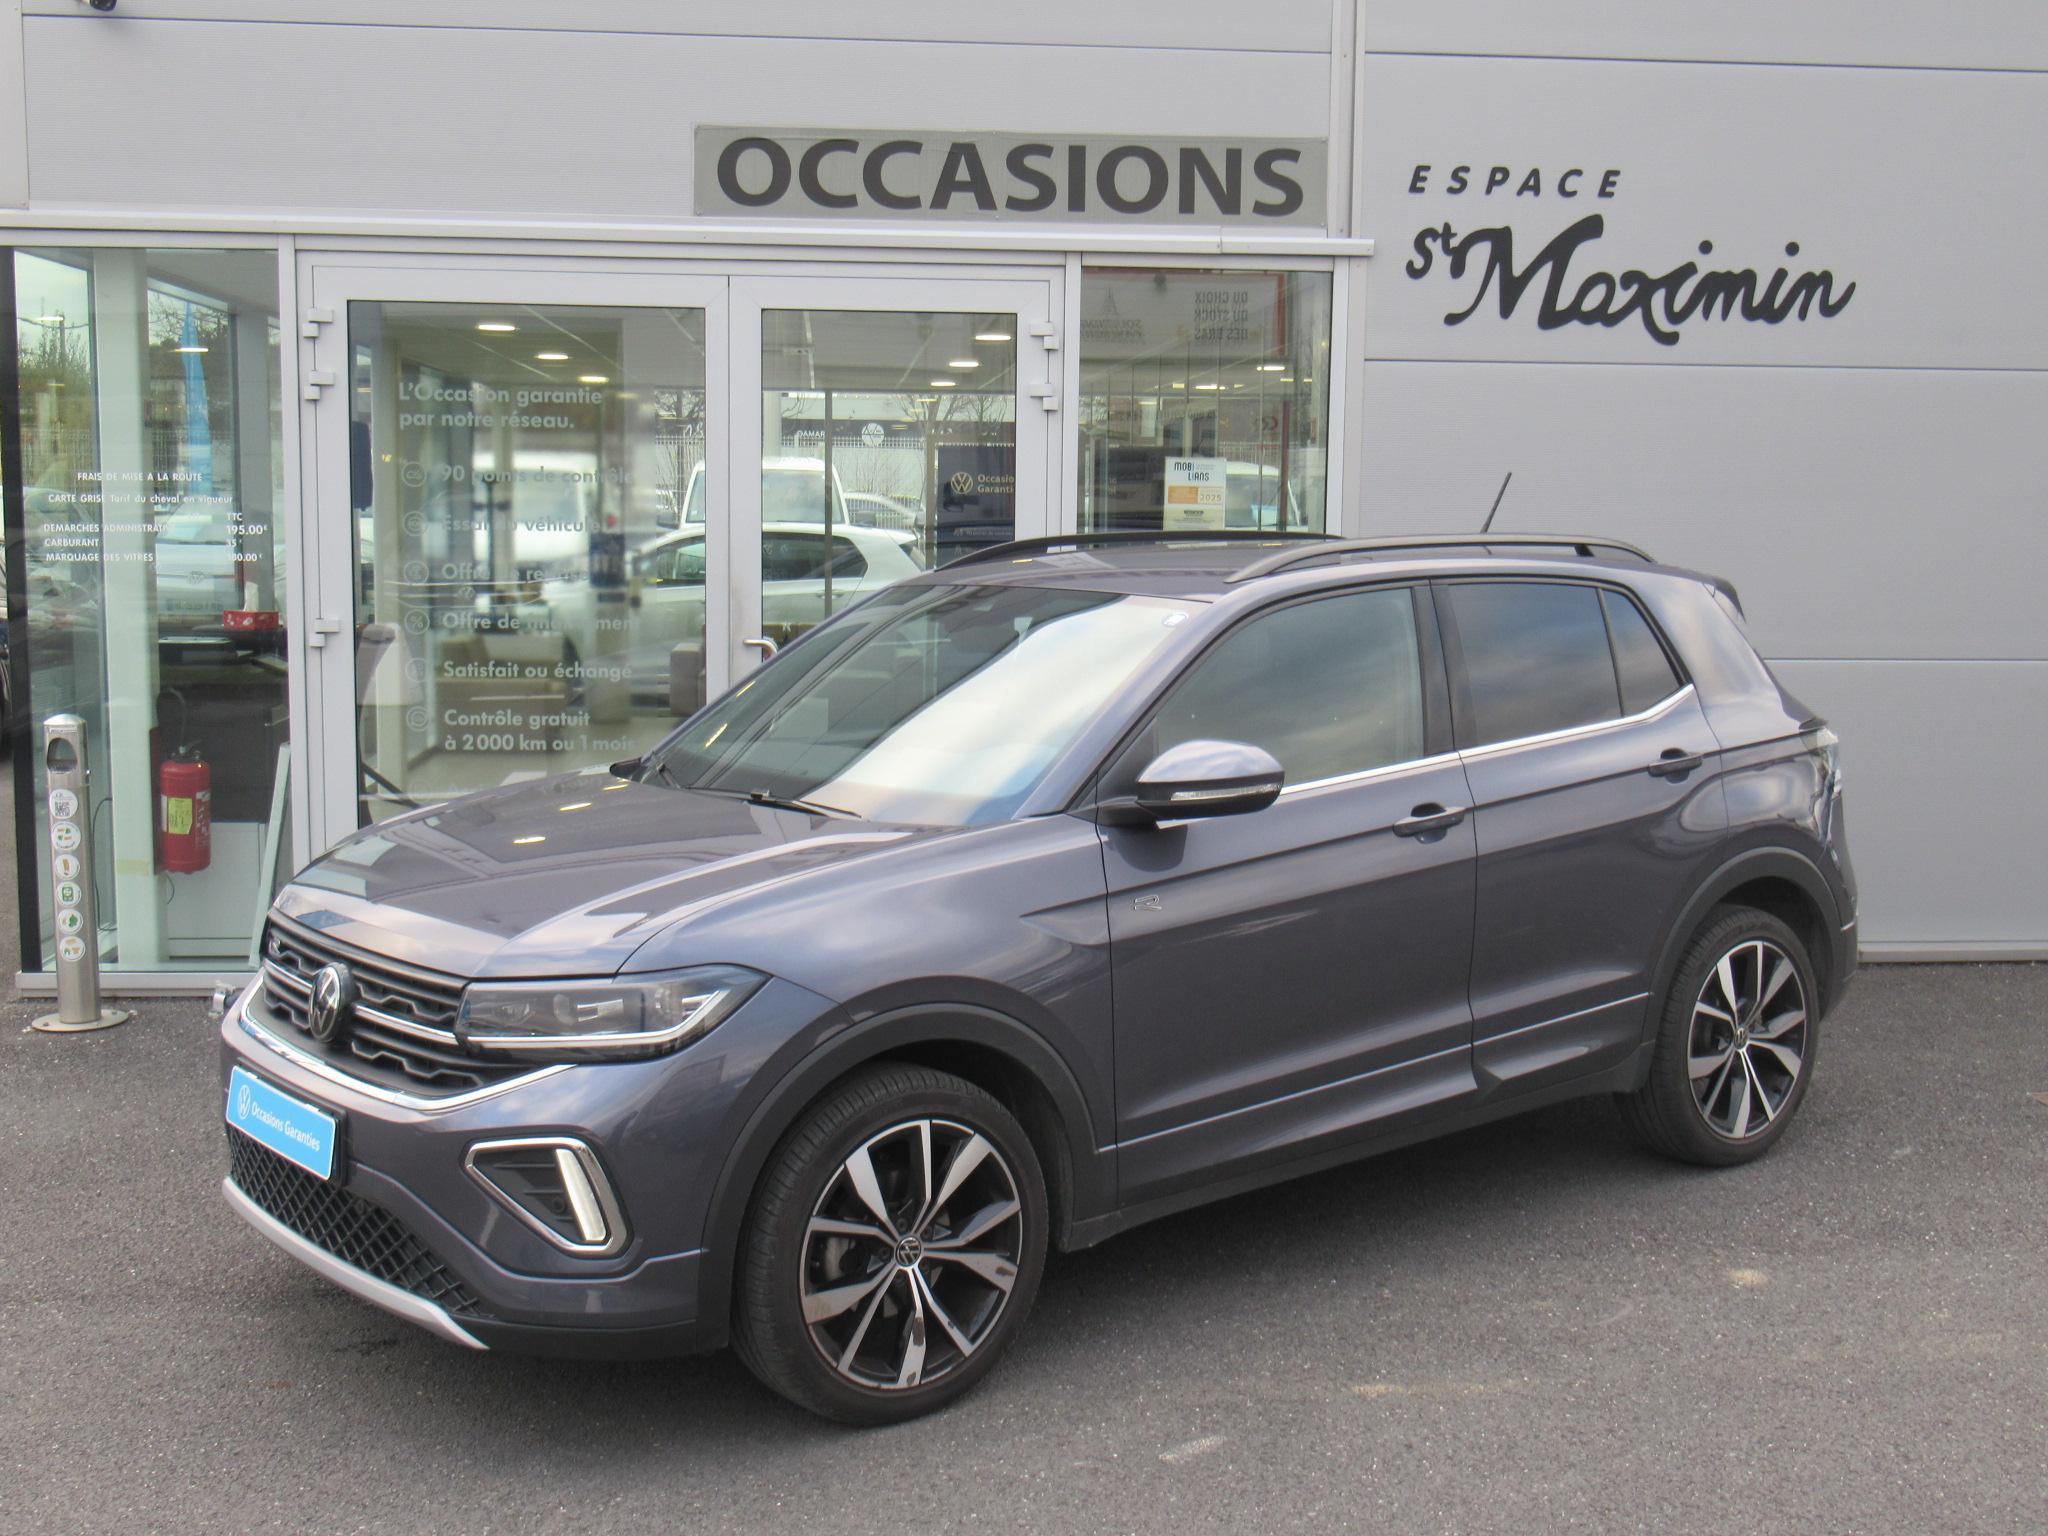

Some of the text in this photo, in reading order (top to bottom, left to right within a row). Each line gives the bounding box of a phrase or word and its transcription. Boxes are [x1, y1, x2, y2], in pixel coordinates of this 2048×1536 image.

[716, 136, 1304, 217] OCCASIONS
[1408, 164, 1621, 198] ESPACE
[1444, 213, 1857, 346] Maximin
[398, 382, 603, 407] L'Occason garantie
[399, 410, 575, 431] par notre réseau.
[77, 472, 102, 481] FRAIS
[122, 472, 143, 481] MISE
[147, 472, 154, 481] A
[157, 472, 169, 481] LA
[172, 472, 203, 481] ROUTE
[440, 464, 465, 482] 90
[48, 494, 76, 503] CARTE
[150, 493, 180, 503] cheval
[44, 538, 99, 547] CARBURANT
[46, 552, 100, 562] MARQUAGE
[442, 611, 492, 629] Offre
[497, 611, 521, 629] de
[443, 660, 633, 682] Satisfait ou échangé
[444, 708, 590, 730] Contrôle gratuit
[444, 734, 457, 751] à
[519, 733, 547, 751] km
[552, 739, 574, 751] ou
[251, 1102, 284, 1131] Occasions
[284, 1120, 321, 1151] Garanties
